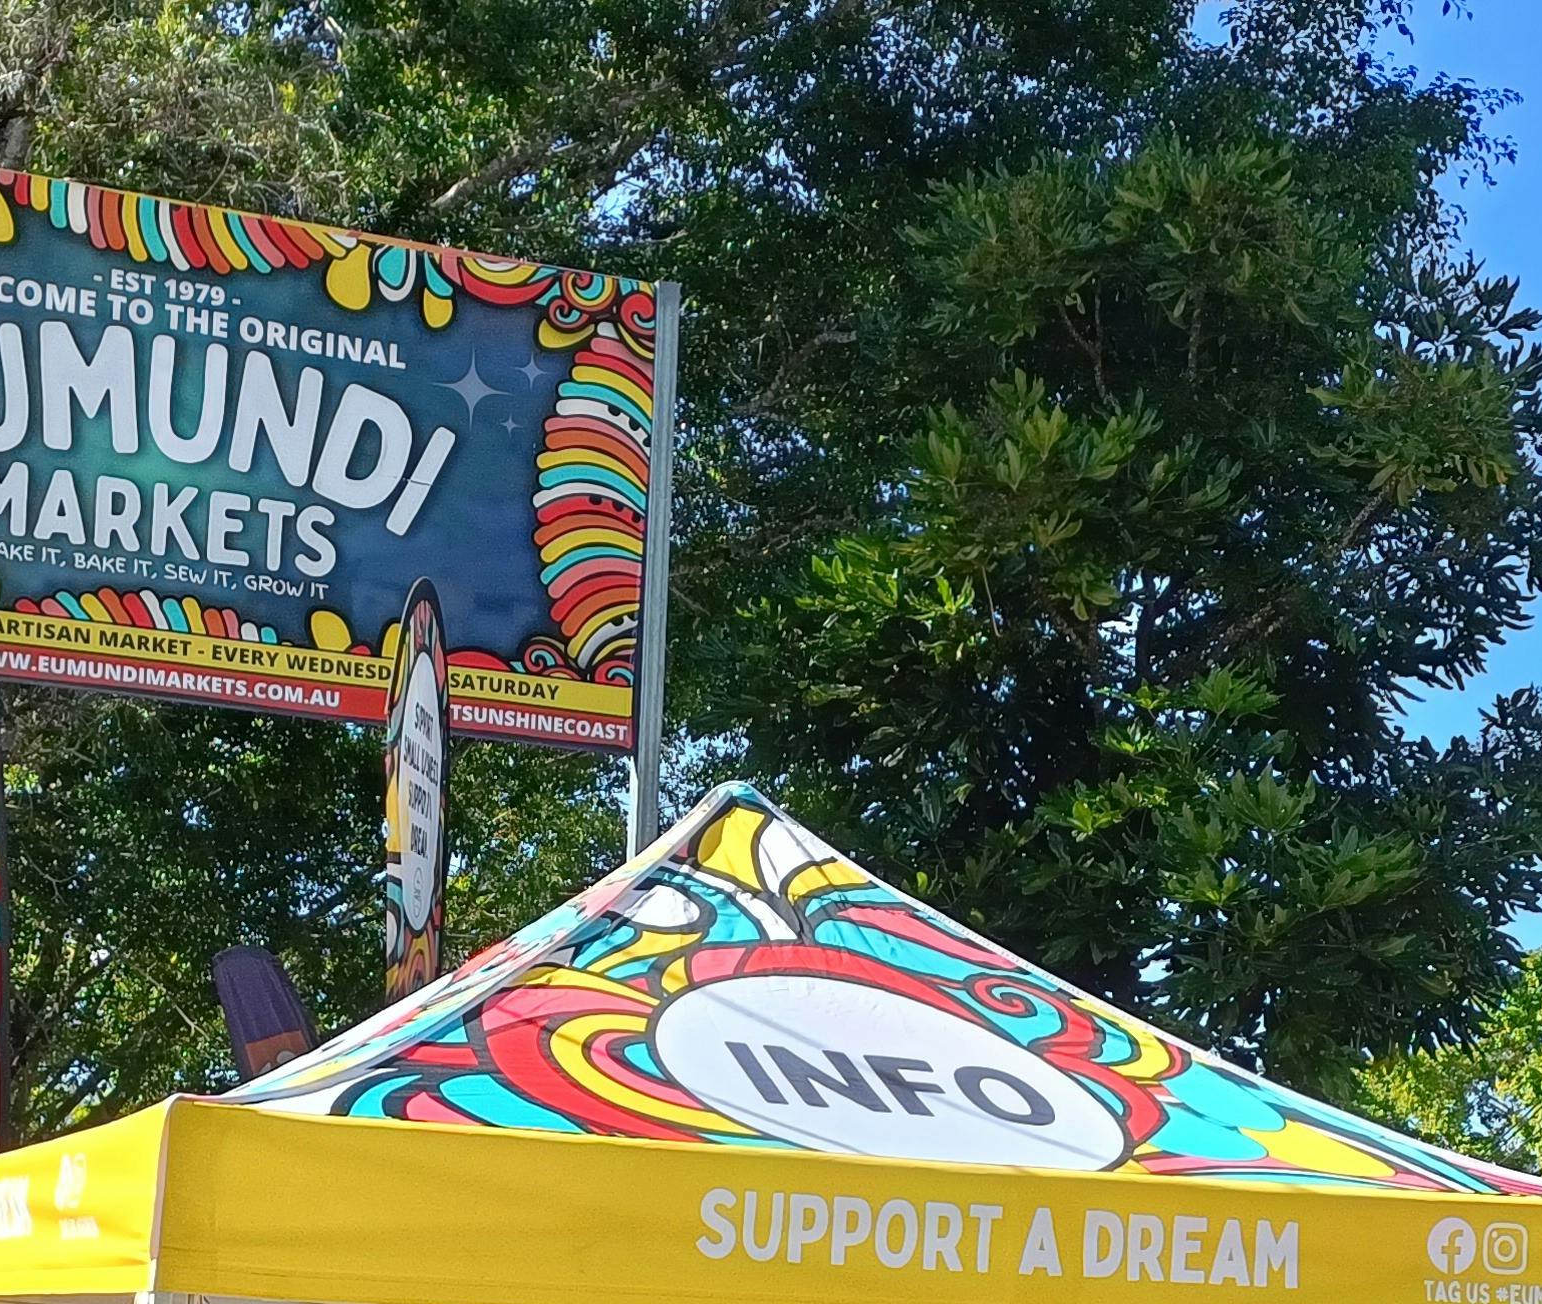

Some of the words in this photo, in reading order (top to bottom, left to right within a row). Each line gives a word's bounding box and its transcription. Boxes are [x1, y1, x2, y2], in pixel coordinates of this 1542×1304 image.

[110, 269, 157, 297] EST
[164, 280, 226, 306] 1979
[107, 294, 154, 325] TO
[165, 303, 229, 339] THE
[239, 317, 407, 370] ORIGINAL
[41, 547, 66, 568] IT,
[74, 552, 126, 575] BAKE
[134, 558, 158, 579] IT,
[164, 564, 207, 586] SEW
[213, 569, 237, 591] IT,
[244, 574, 304, 597] GROW
[310, 581, 329, 600] IT
[99, 629, 192, 658] MARKET
[211, 644, 280, 668] EVERY
[286, 654, 391, 682] WEDNESD
[450, 672, 560, 700] SATURDAY
[450, 704, 628, 742] TSUNSHINECOAST
[723, 1040, 1057, 1127] INFO
[695, 1187, 1003, 1275] SUPPORT
[1020, 1209, 1063, 1277] A
[1081, 1212, 1301, 1290] DREAM
